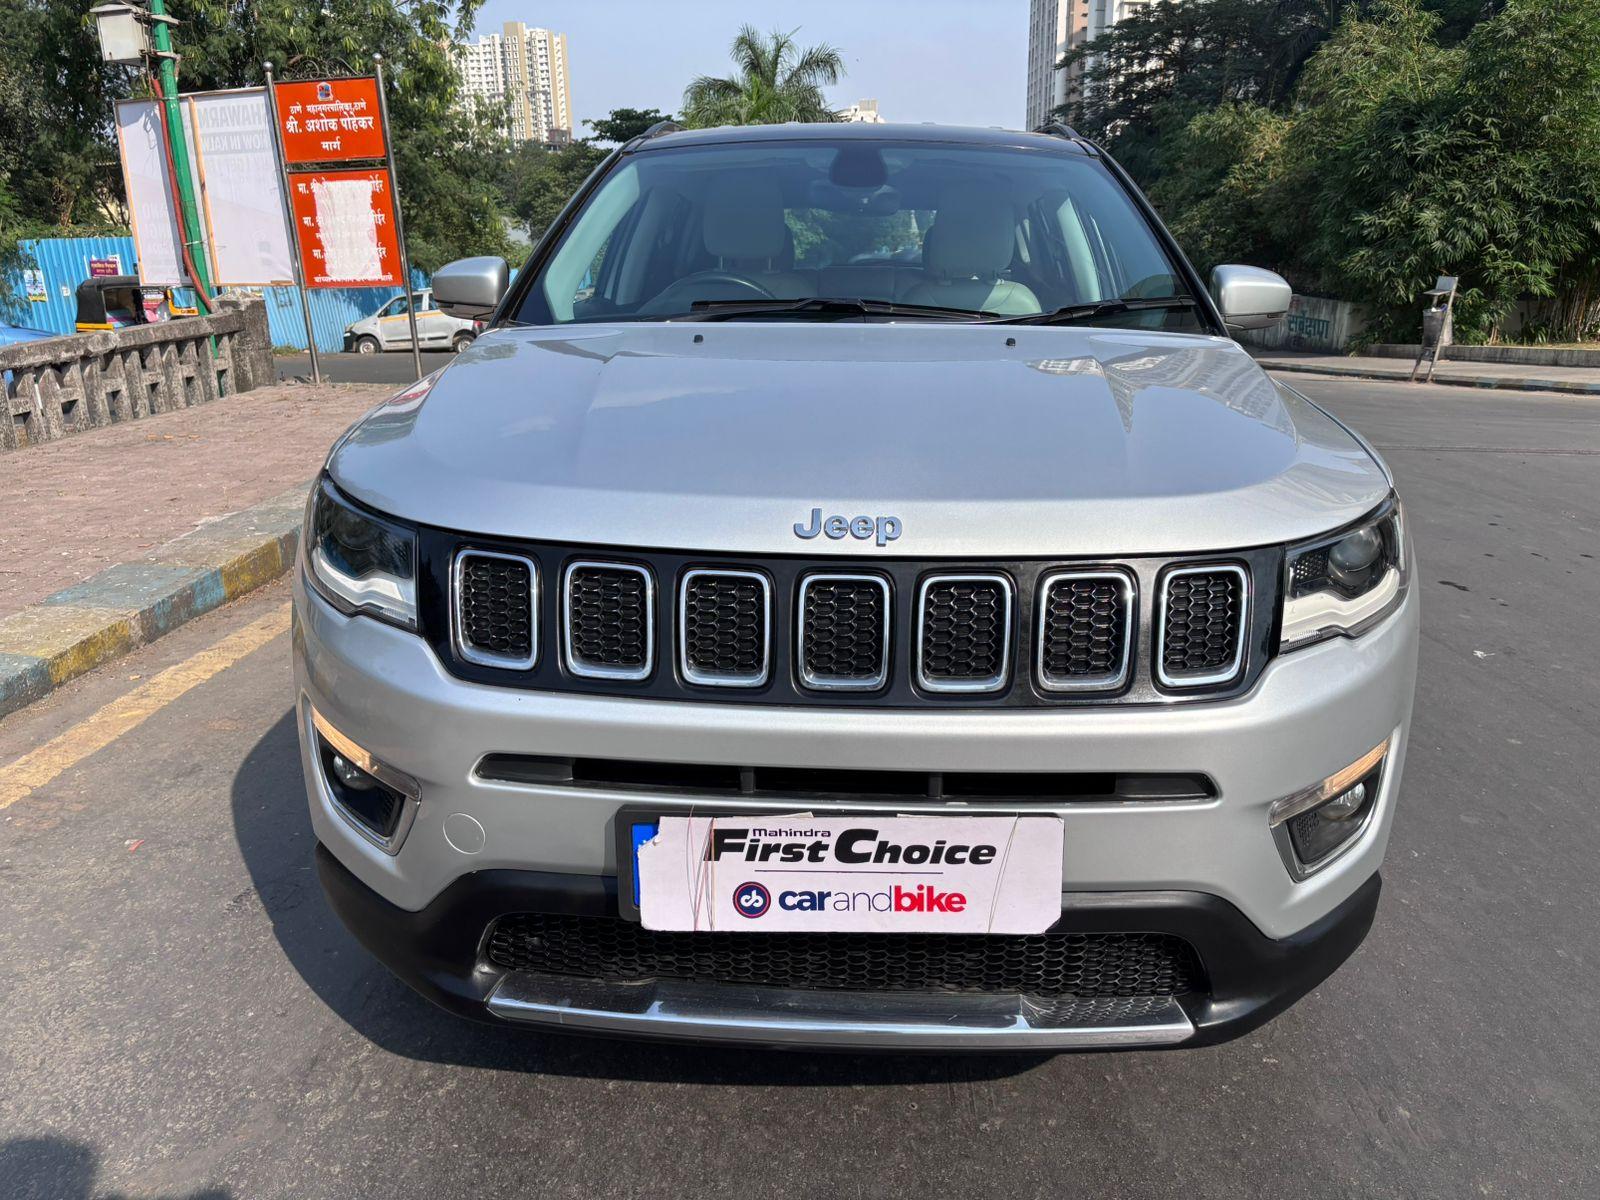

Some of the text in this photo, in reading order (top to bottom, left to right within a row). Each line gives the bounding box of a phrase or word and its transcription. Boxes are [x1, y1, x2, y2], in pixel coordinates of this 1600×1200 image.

[305, 113, 338, 133] अशोक
[340, 111, 374, 132] पोहेकर
[320, 136, 341, 151] मार्ग
[793, 508, 903, 548] Jeep
[752, 828, 831, 838] Mahindra
[703, 828, 997, 865] First Choice
[778, 885, 967, 914] carandbike
